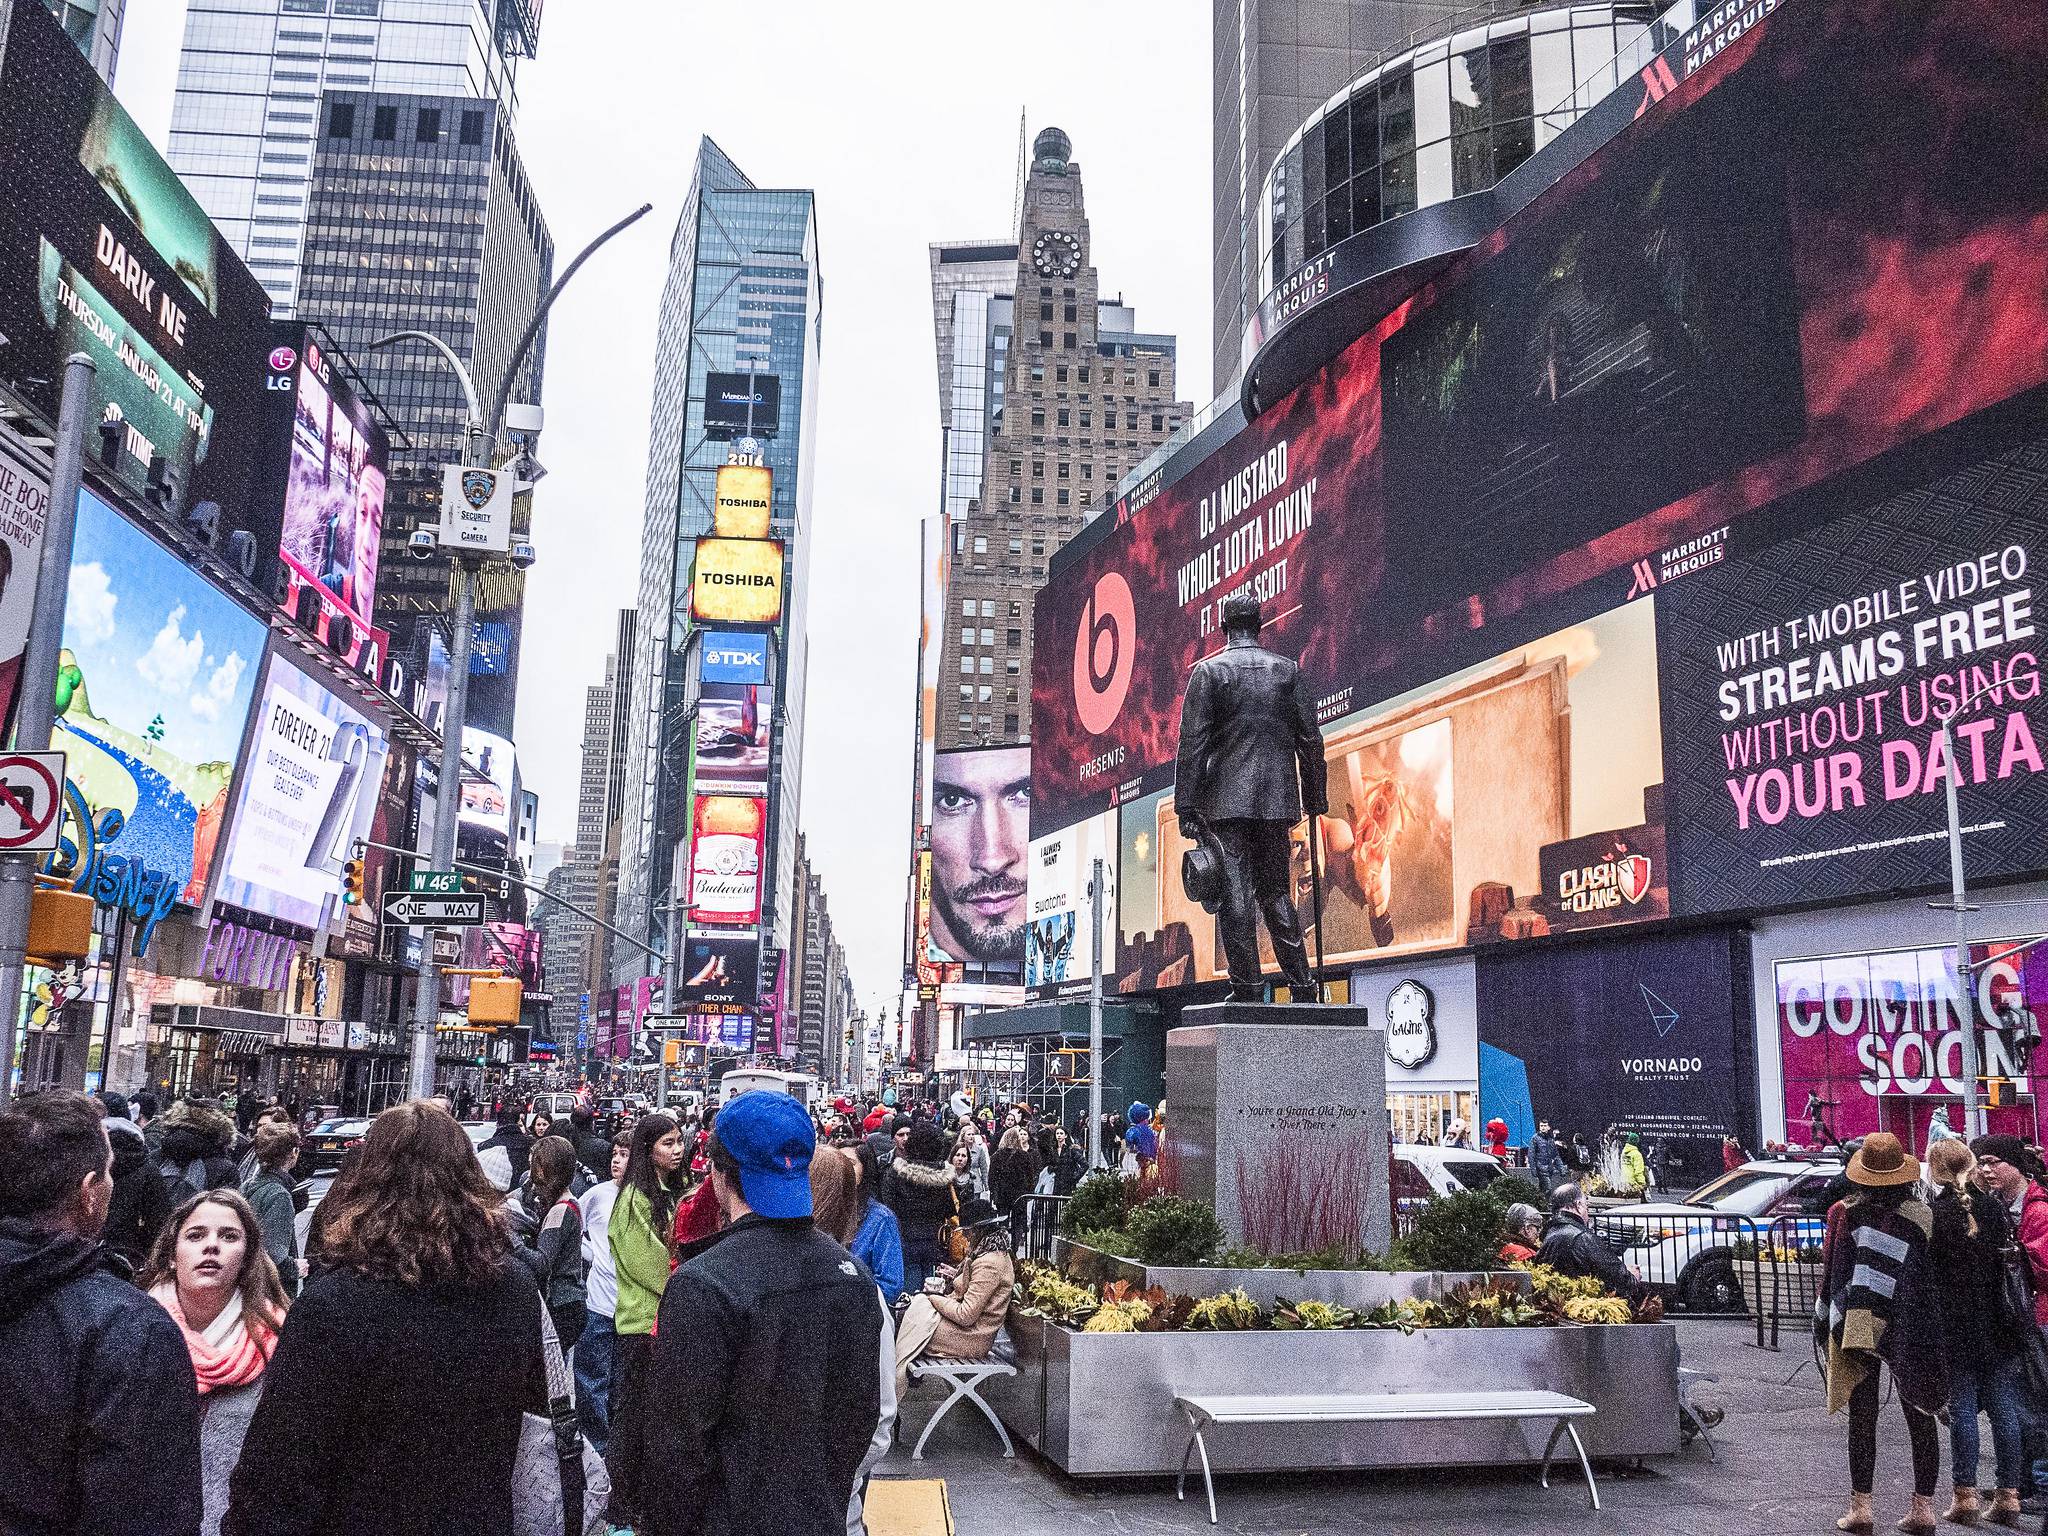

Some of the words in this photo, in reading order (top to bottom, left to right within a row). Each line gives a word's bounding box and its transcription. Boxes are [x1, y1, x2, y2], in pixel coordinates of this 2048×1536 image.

[1685, 0, 1755, 53] MARRI
[1687, 0, 1776, 75] MARQUIS
[96, 223, 155, 313] DARK
[159, 292, 187, 347] NE
[1267, 251, 1336, 312] MARRIOTT
[1267, 278, 1327, 330] MARQUIS
[57, 277, 118, 349] THURSDAY
[116, 340, 163, 394] JANUARY
[162, 383, 173, 405] 21
[173, 399, 186, 418] AT
[187, 407, 209, 441] 11PM
[318, 356, 330, 384] LG
[267, 376, 291, 391] LG
[728, 453, 764, 466] 2016
[1130, 484, 1160, 515] MARQUIS
[1131, 467, 1164, 502] MARRIOTT
[1200, 498, 1217, 541] DJ
[1220, 440, 1288, 526] MUSTARD
[461, 510, 491, 523] SECURITY
[719, 498, 768, 508] TOSHIBA
[12, 507, 44, 536] HOME
[414, 534, 431, 545] NYPD
[461, 531, 488, 543] CAMERA
[516, 546, 532, 556] NYPD
[1177, 549, 1221, 608] WHOLE
[1224, 521, 1264, 579] LOTTA
[1268, 478, 1318, 554] LOVIN'
[1662, 526, 1730, 565] MARRIOTT
[1662, 547, 1722, 580] MARQUIS
[702, 572, 775, 587] TOSHIBA
[1201, 604, 1215, 638] FT.
[1254, 558, 1288, 604] SCOTT
[1716, 626, 1779, 673] WITH
[1785, 579, 1919, 650] T-MOBILE
[1923, 544, 2027, 605] VIDEO
[719, 651, 763, 666] TDK
[1718, 629, 1905, 722] STREAMS
[1913, 589, 2036, 668] FREE
[1317, 686, 1353, 710] MARRIOTT
[1317, 701, 1349, 721] MARQUIS
[1722, 690, 1889, 771] WITHOUT
[1900, 651, 2041, 727] USING
[271, 704, 318, 754] FOREVER
[317, 735, 331, 762] 21
[1080, 745, 1125, 782] PRESENTS
[1726, 751, 1867, 830] YOUR
[1881, 711, 2045, 801] DATA
[1043, 841, 1062, 857] ALWAYS
[1044, 854, 1058, 868] WANT
[414, 875, 425, 890] W
[429, 874, 450, 890] 46
[696, 879, 755, 894] Budweiser
[1559, 862, 1618, 899] CLASH
[396, 903, 427, 915] ONE
[444, 904, 476, 916] WAY
[1572, 885, 1622, 913] CLANS
[199, 918, 298, 991] FOREVER
[704, 994, 735, 1002] SONY
[1786, 961, 2024, 1038] COMING
[1621, 1057, 1703, 1074] VORNADO
[1857, 1030, 2029, 1096] SOON
[1276, 1108, 1283, 1116] a
[1285, 1105, 1314, 1117] Grand
[1318, 1105, 1334, 1116] Old
[1337, 1105, 1358, 1119] Flag
[1278, 1118, 1301, 1130] Over
[1301, 1118, 1326, 1130] There
